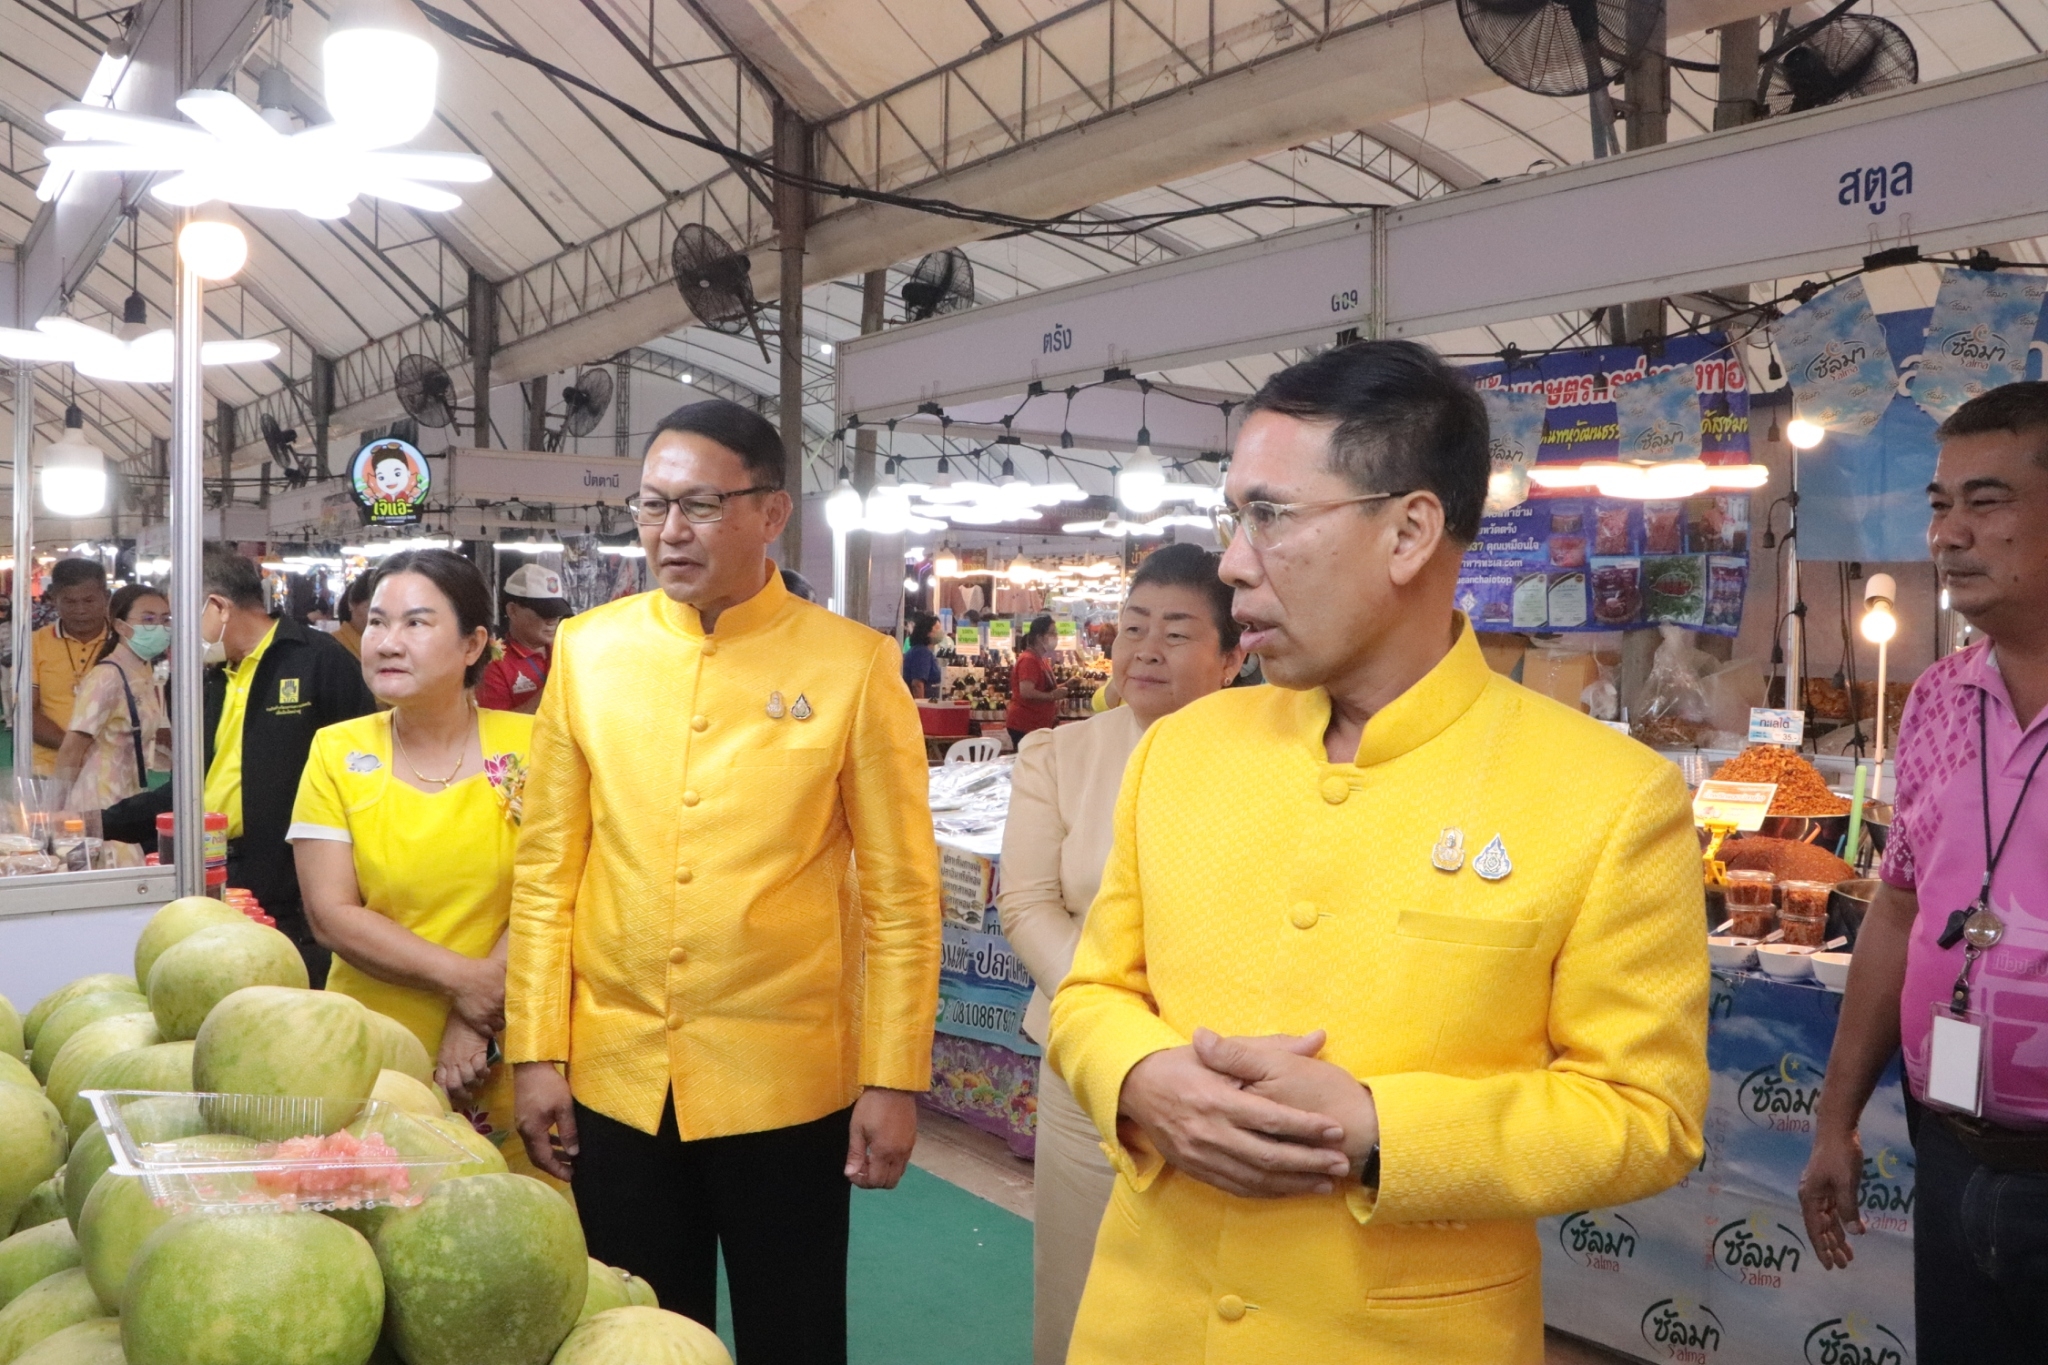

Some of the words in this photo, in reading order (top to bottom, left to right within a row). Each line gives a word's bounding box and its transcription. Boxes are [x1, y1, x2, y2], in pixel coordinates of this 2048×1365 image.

[1838, 161, 1913, 215] สตูล
[1331, 289, 1358, 312] G09
[1043, 323, 1072, 354] ตรัง
[1951, 336, 2007, 362] ซัลมา
[1813, 346, 1867, 379] ซัลมา
[1641, 430, 1684, 451] ซัลมา
[583, 469, 619, 488] ปัตตานี
[1752, 1073, 1819, 1116] ซัลม
[1768, 1112, 1810, 1133] Salma
[1863, 1210, 1908, 1232] Salma
[1570, 1219, 1636, 1259] ซัลมา
[1724, 1230, 1801, 1273] ซัลมา
[1585, 1252, 1620, 1272] Salma
[1739, 1268, 1782, 1289] Salma
[1653, 1308, 1720, 1351] ซัลมา
[1667, 1344, 1707, 1365] Salma
[1818, 1330, 1903, 1365] ซัลมา
